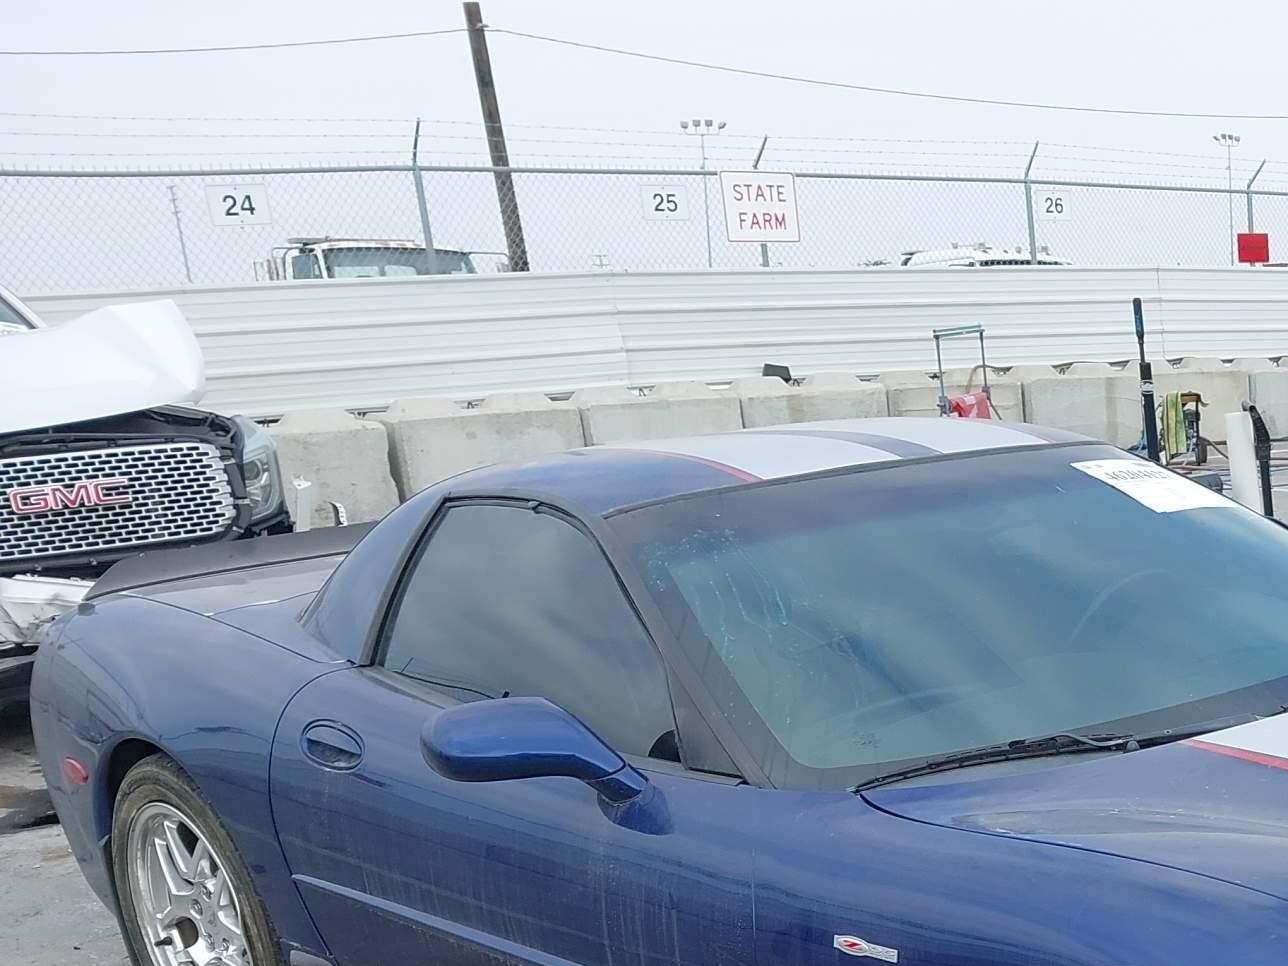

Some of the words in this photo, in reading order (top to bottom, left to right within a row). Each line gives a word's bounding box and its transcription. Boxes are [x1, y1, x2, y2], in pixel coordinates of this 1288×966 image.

[732, 184, 787, 202] STATE
[222, 194, 256, 216] 24
[652, 193, 678, 213] 25
[1045, 197, 1064, 214] 26
[738, 212, 787, 230] FARM
[9, 478, 132, 514] GMC
